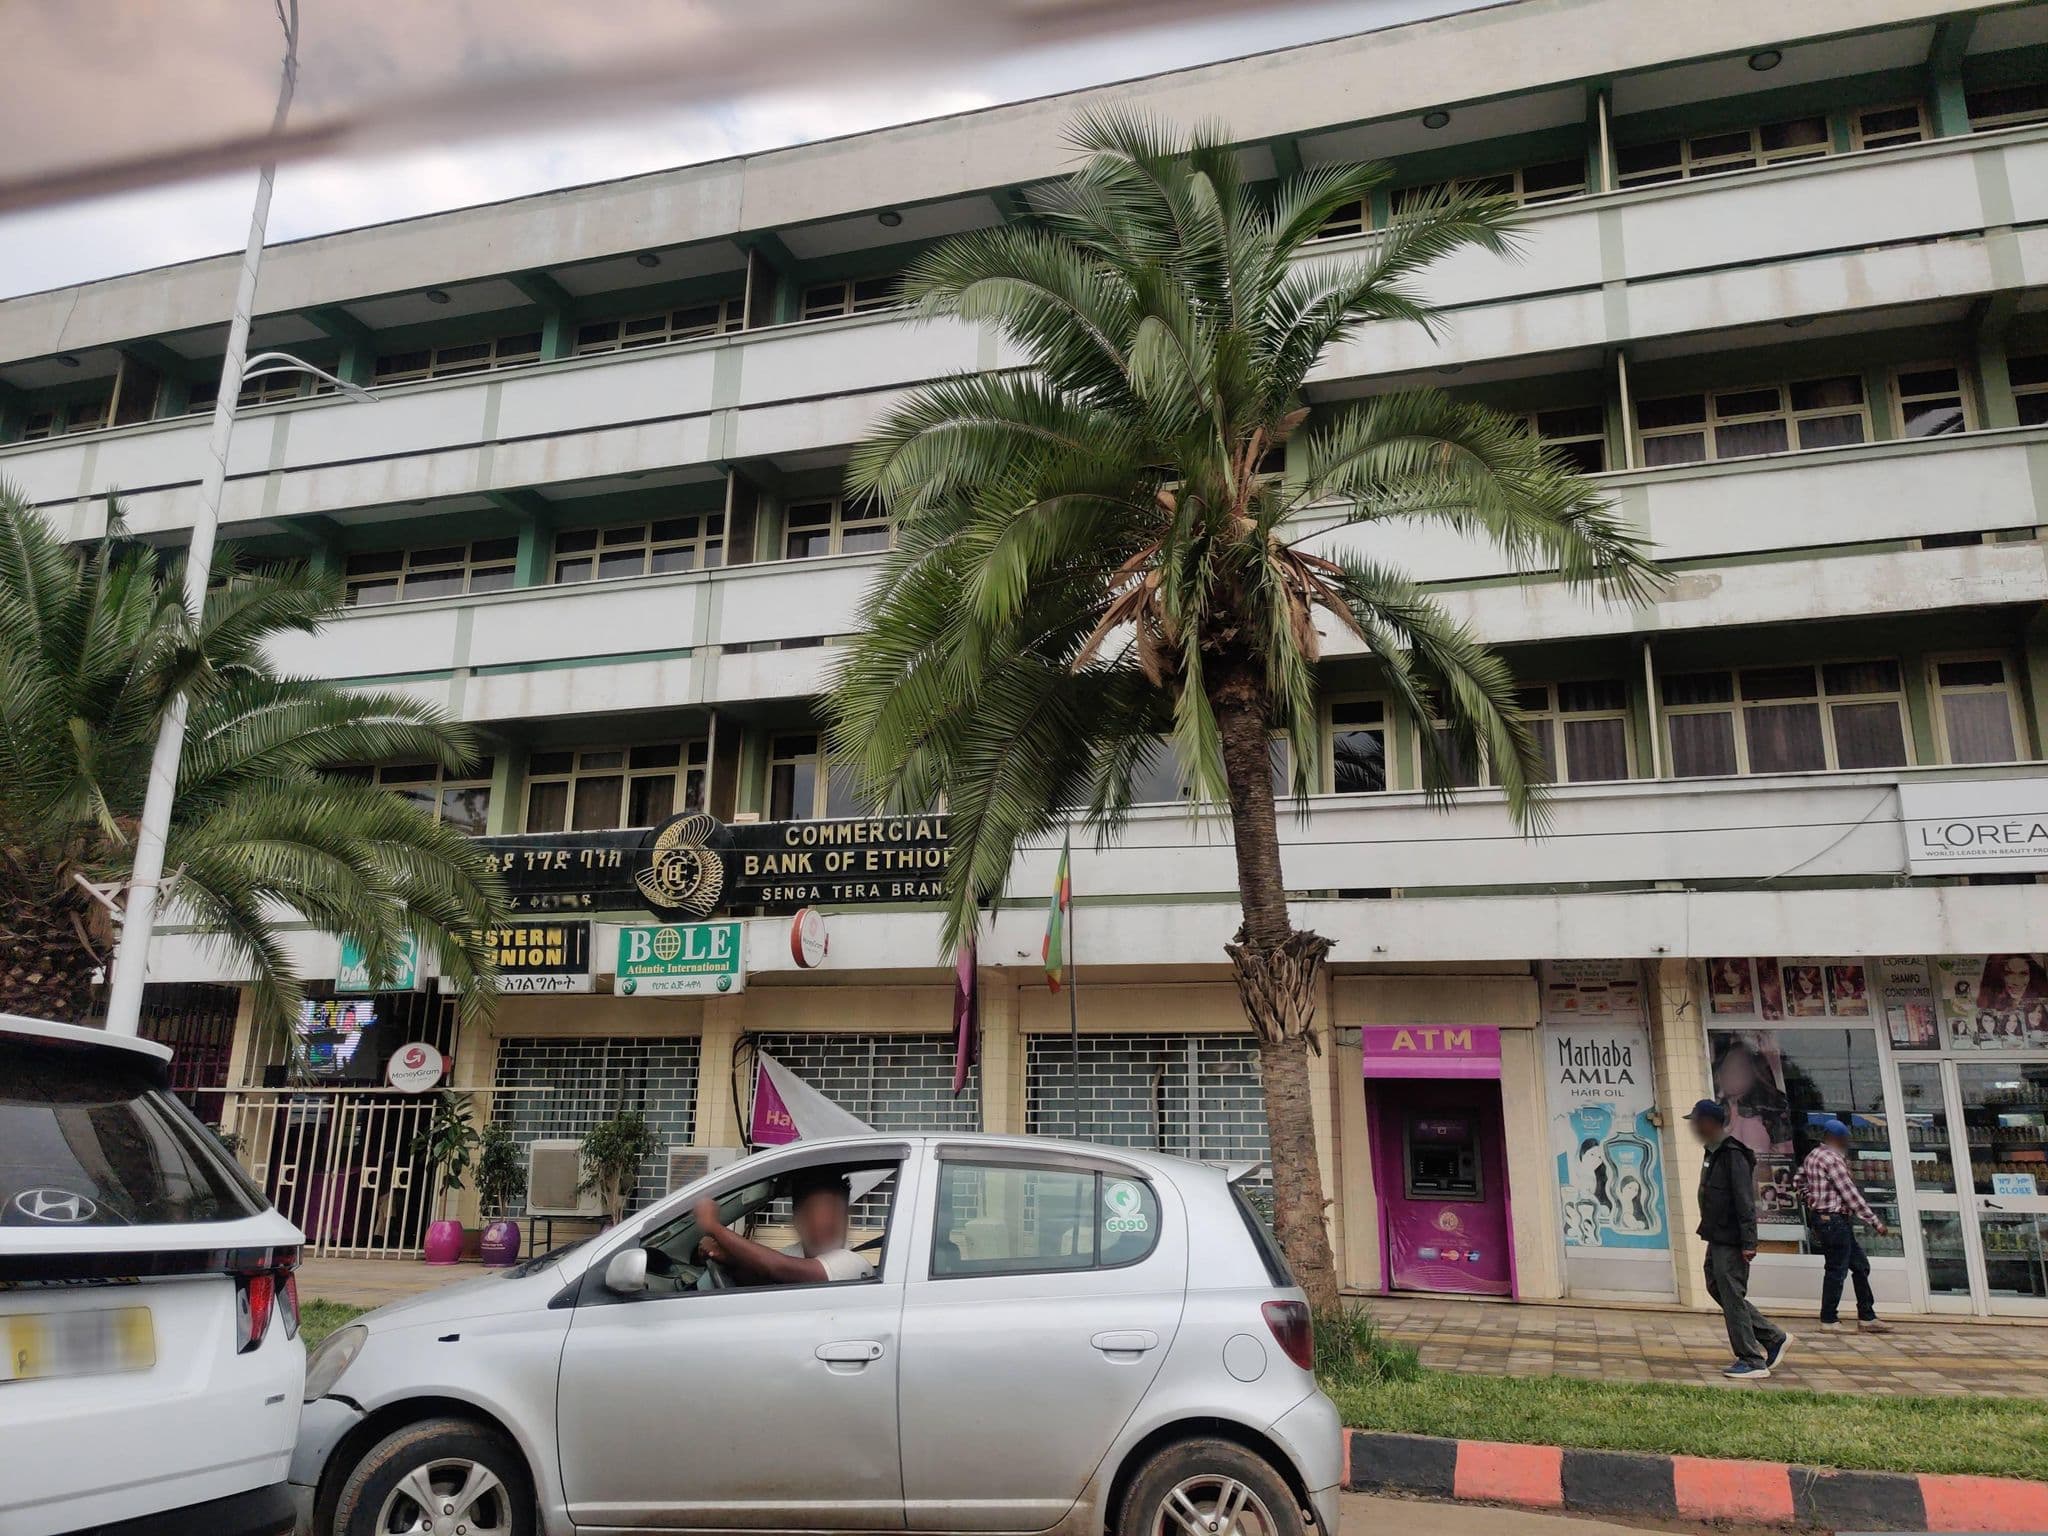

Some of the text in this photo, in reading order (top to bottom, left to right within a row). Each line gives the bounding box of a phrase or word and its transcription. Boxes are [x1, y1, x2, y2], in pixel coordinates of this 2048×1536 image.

[785, 819, 948, 846] COMMERCIAL
[745, 852, 813, 876] BANK
[825, 851, 855, 872] OF
[762, 886, 820, 901] SENGA
[832, 884, 880, 898] TERA
[627, 961, 730, 975] Atlantic International
[1391, 1029, 1474, 1051] ATM
[1557, 1037, 1632, 1067] Marhaba
[392, 1069, 440, 1080] MoneyGram
[1560, 1068, 1635, 1085] AMLA
[1571, 1089, 1625, 1097] HAIR OIL
[1108, 1220, 1147, 1231] 6090
